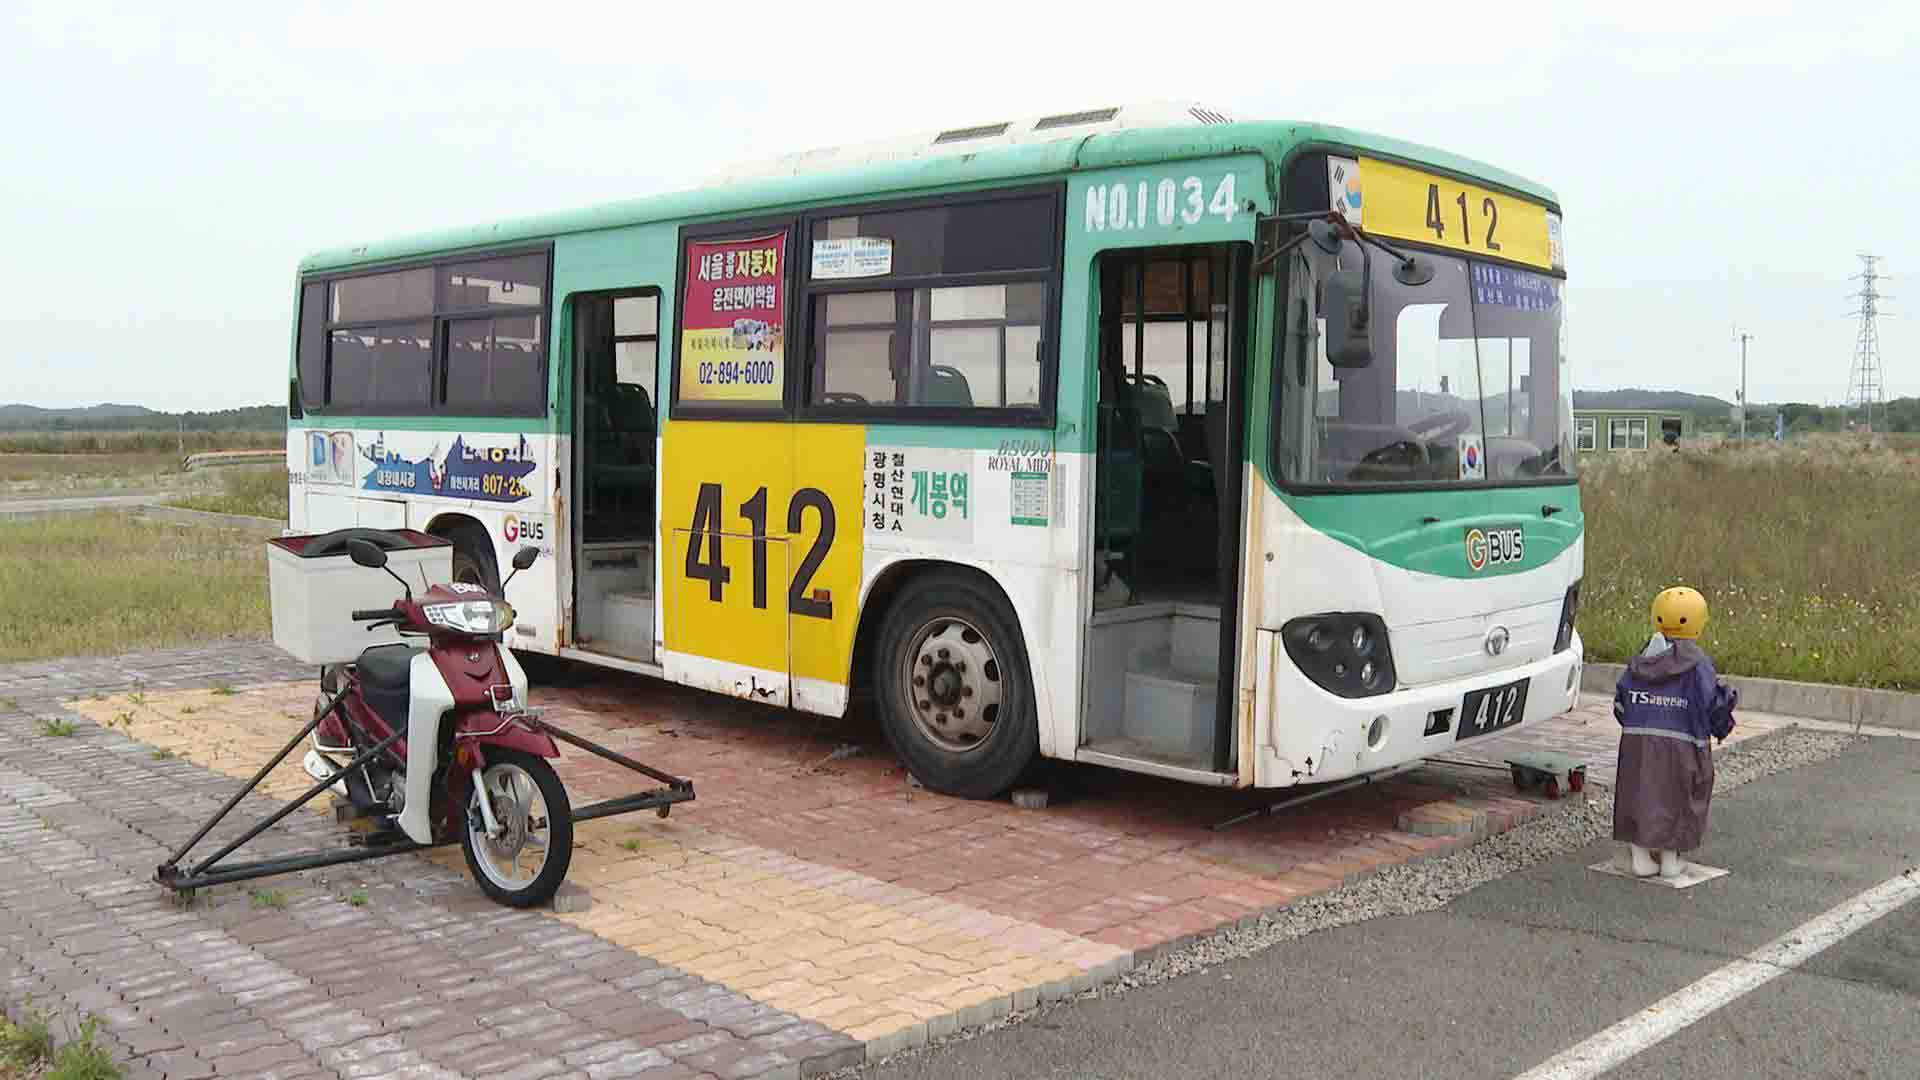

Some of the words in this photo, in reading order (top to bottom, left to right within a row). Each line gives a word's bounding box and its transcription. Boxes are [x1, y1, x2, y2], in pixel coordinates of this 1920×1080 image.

[1426, 183, 1501, 252] 412
[699, 359, 774, 385] 02-894-6000
[987, 455, 1023, 471] ROYAL
[1024, 457, 1052, 473] MIDI
[910, 470, 969, 520] 개봉역
[520, 520, 545, 541] BUS
[1487, 529, 1524, 563] BUS
[685, 481, 837, 621] 412
[1474, 686, 1518, 730] 412
[1628, 689, 1649, 704] TS
